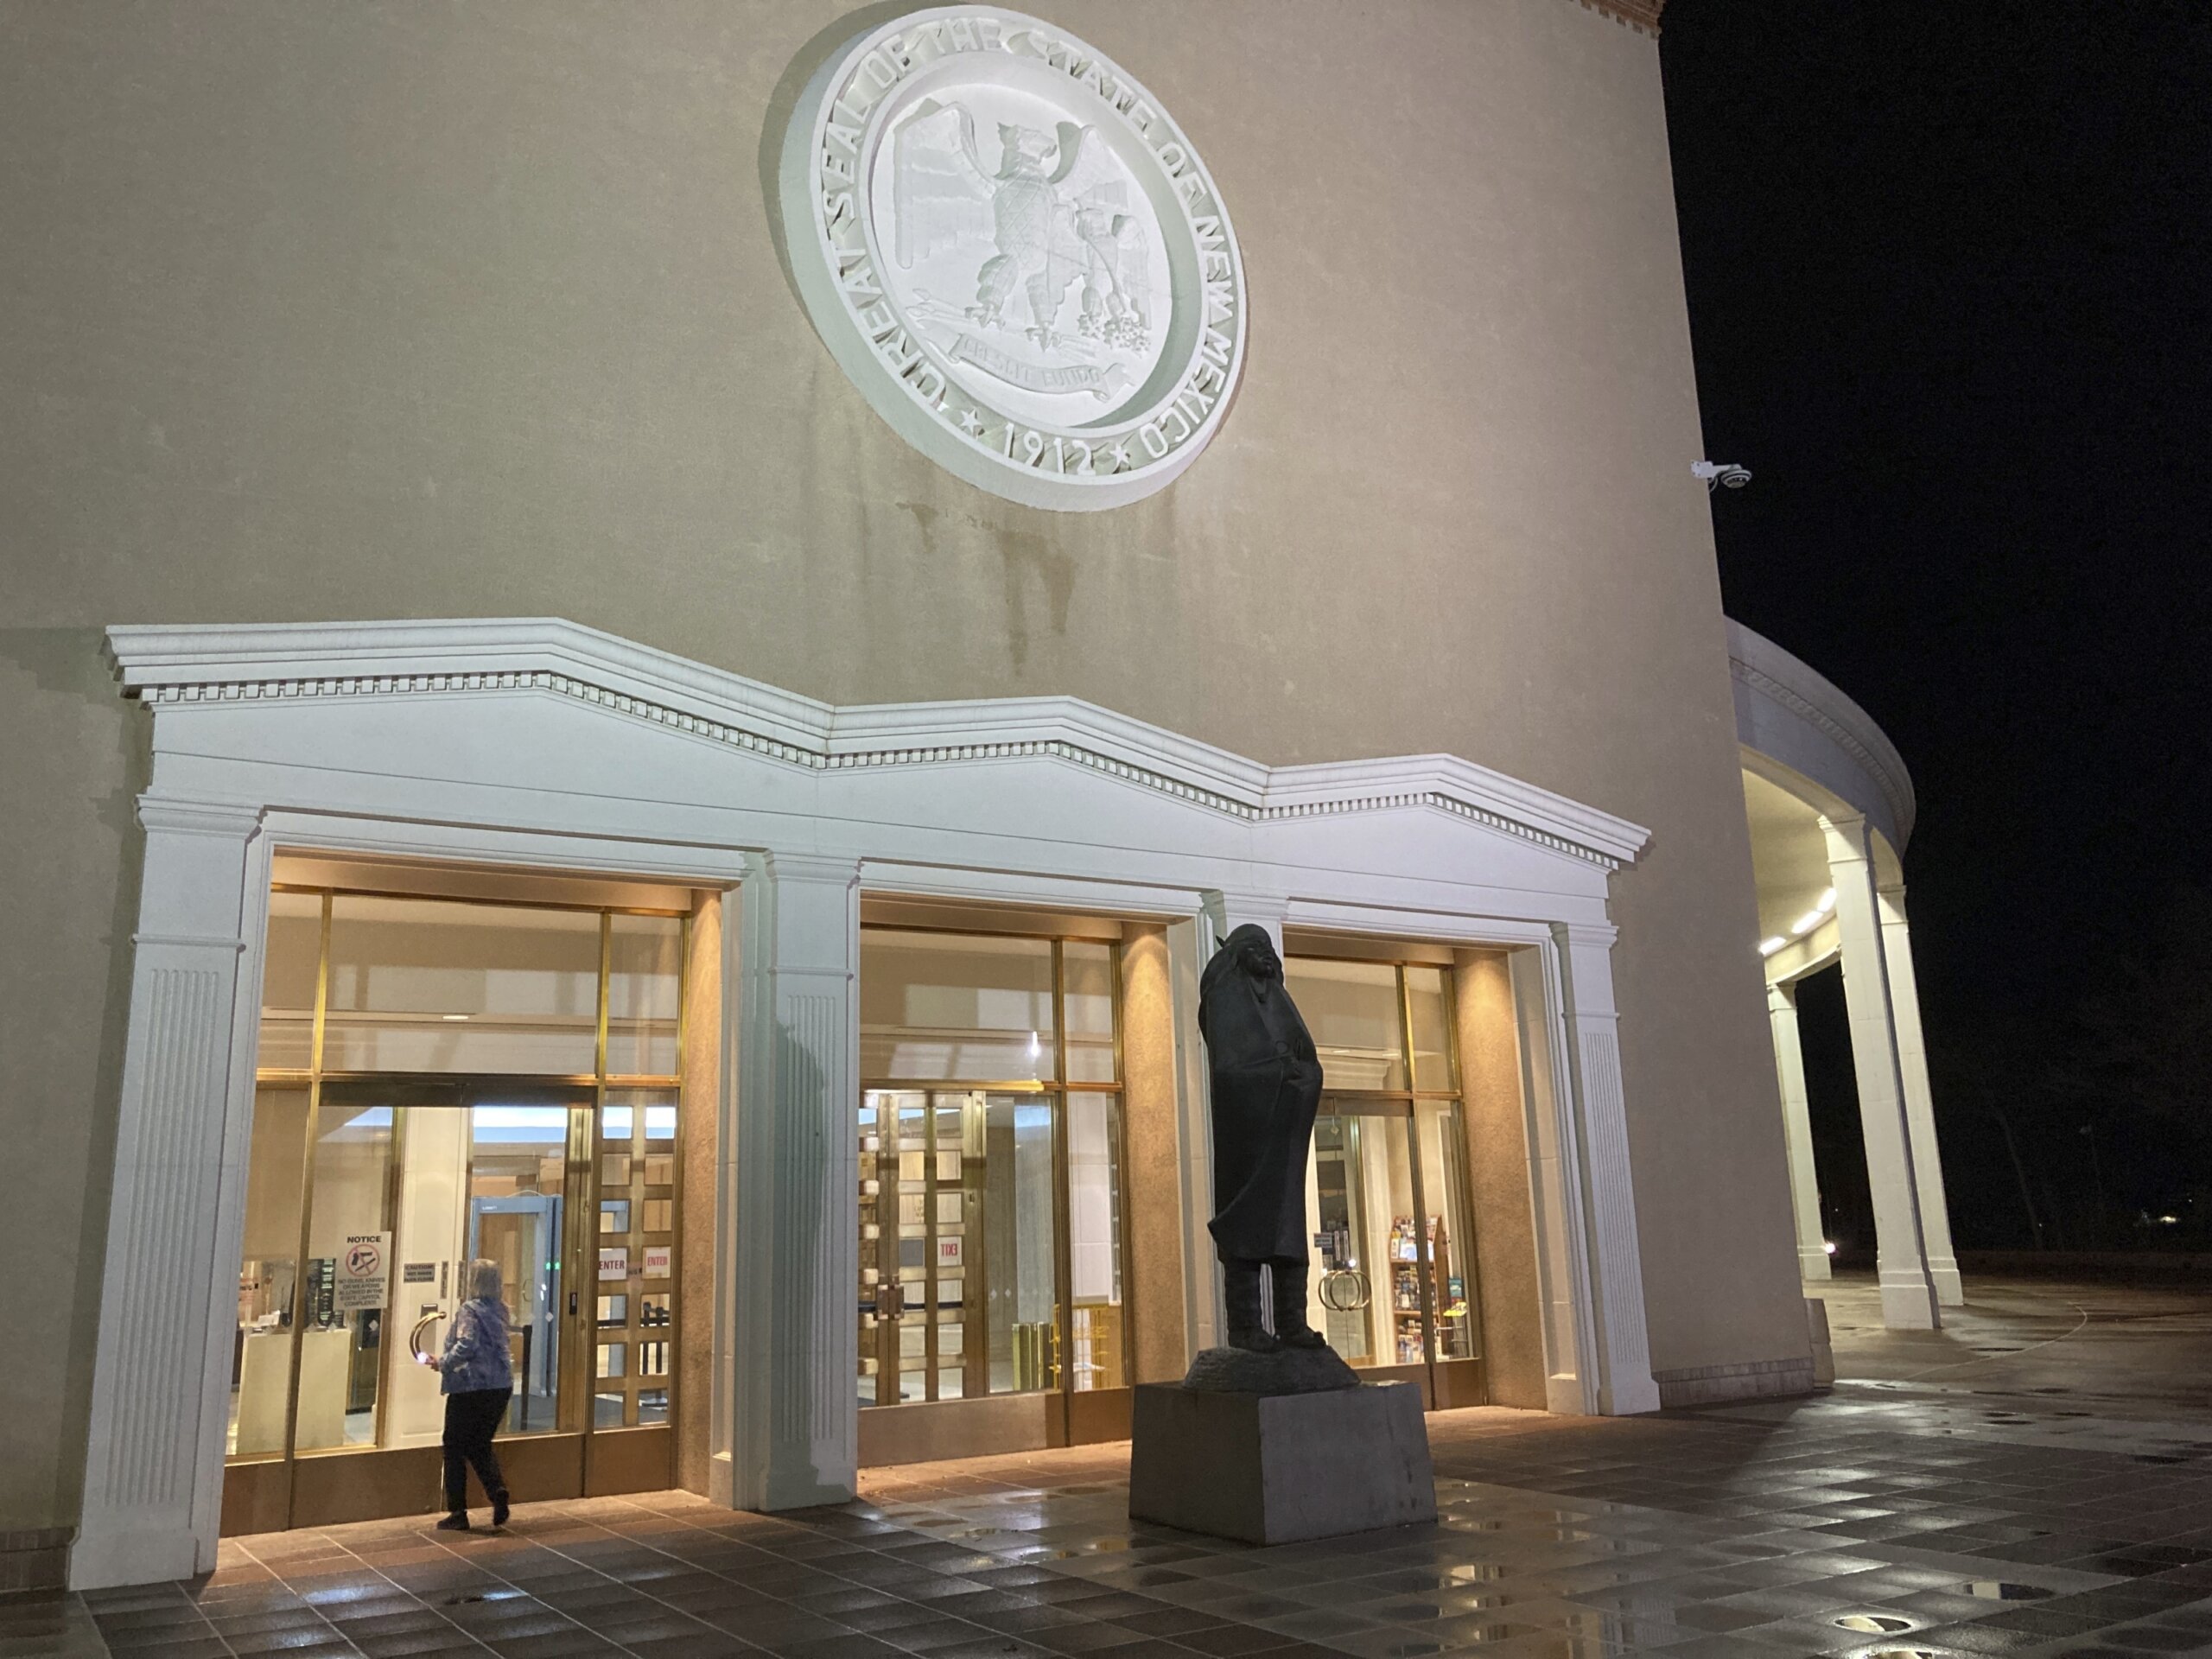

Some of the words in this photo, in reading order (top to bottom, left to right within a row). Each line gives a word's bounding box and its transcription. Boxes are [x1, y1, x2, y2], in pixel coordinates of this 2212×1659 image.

[861, 34, 907, 89] OF
[914, 18, 1003, 55] THE
[1027, 29, 1157, 138] STATE
[822, 99, 871, 219] SEAL
[1156, 141, 1208, 194] OF
[1192, 216, 1234, 318] NEW
[830, 240, 946, 405] GREAT
[1140, 327, 1232, 459] MEXICO
[1004, 422, 1096, 475] 1912
[599, 1260, 625, 1270] ENTER
[647, 1255, 668, 1266] ENTER
